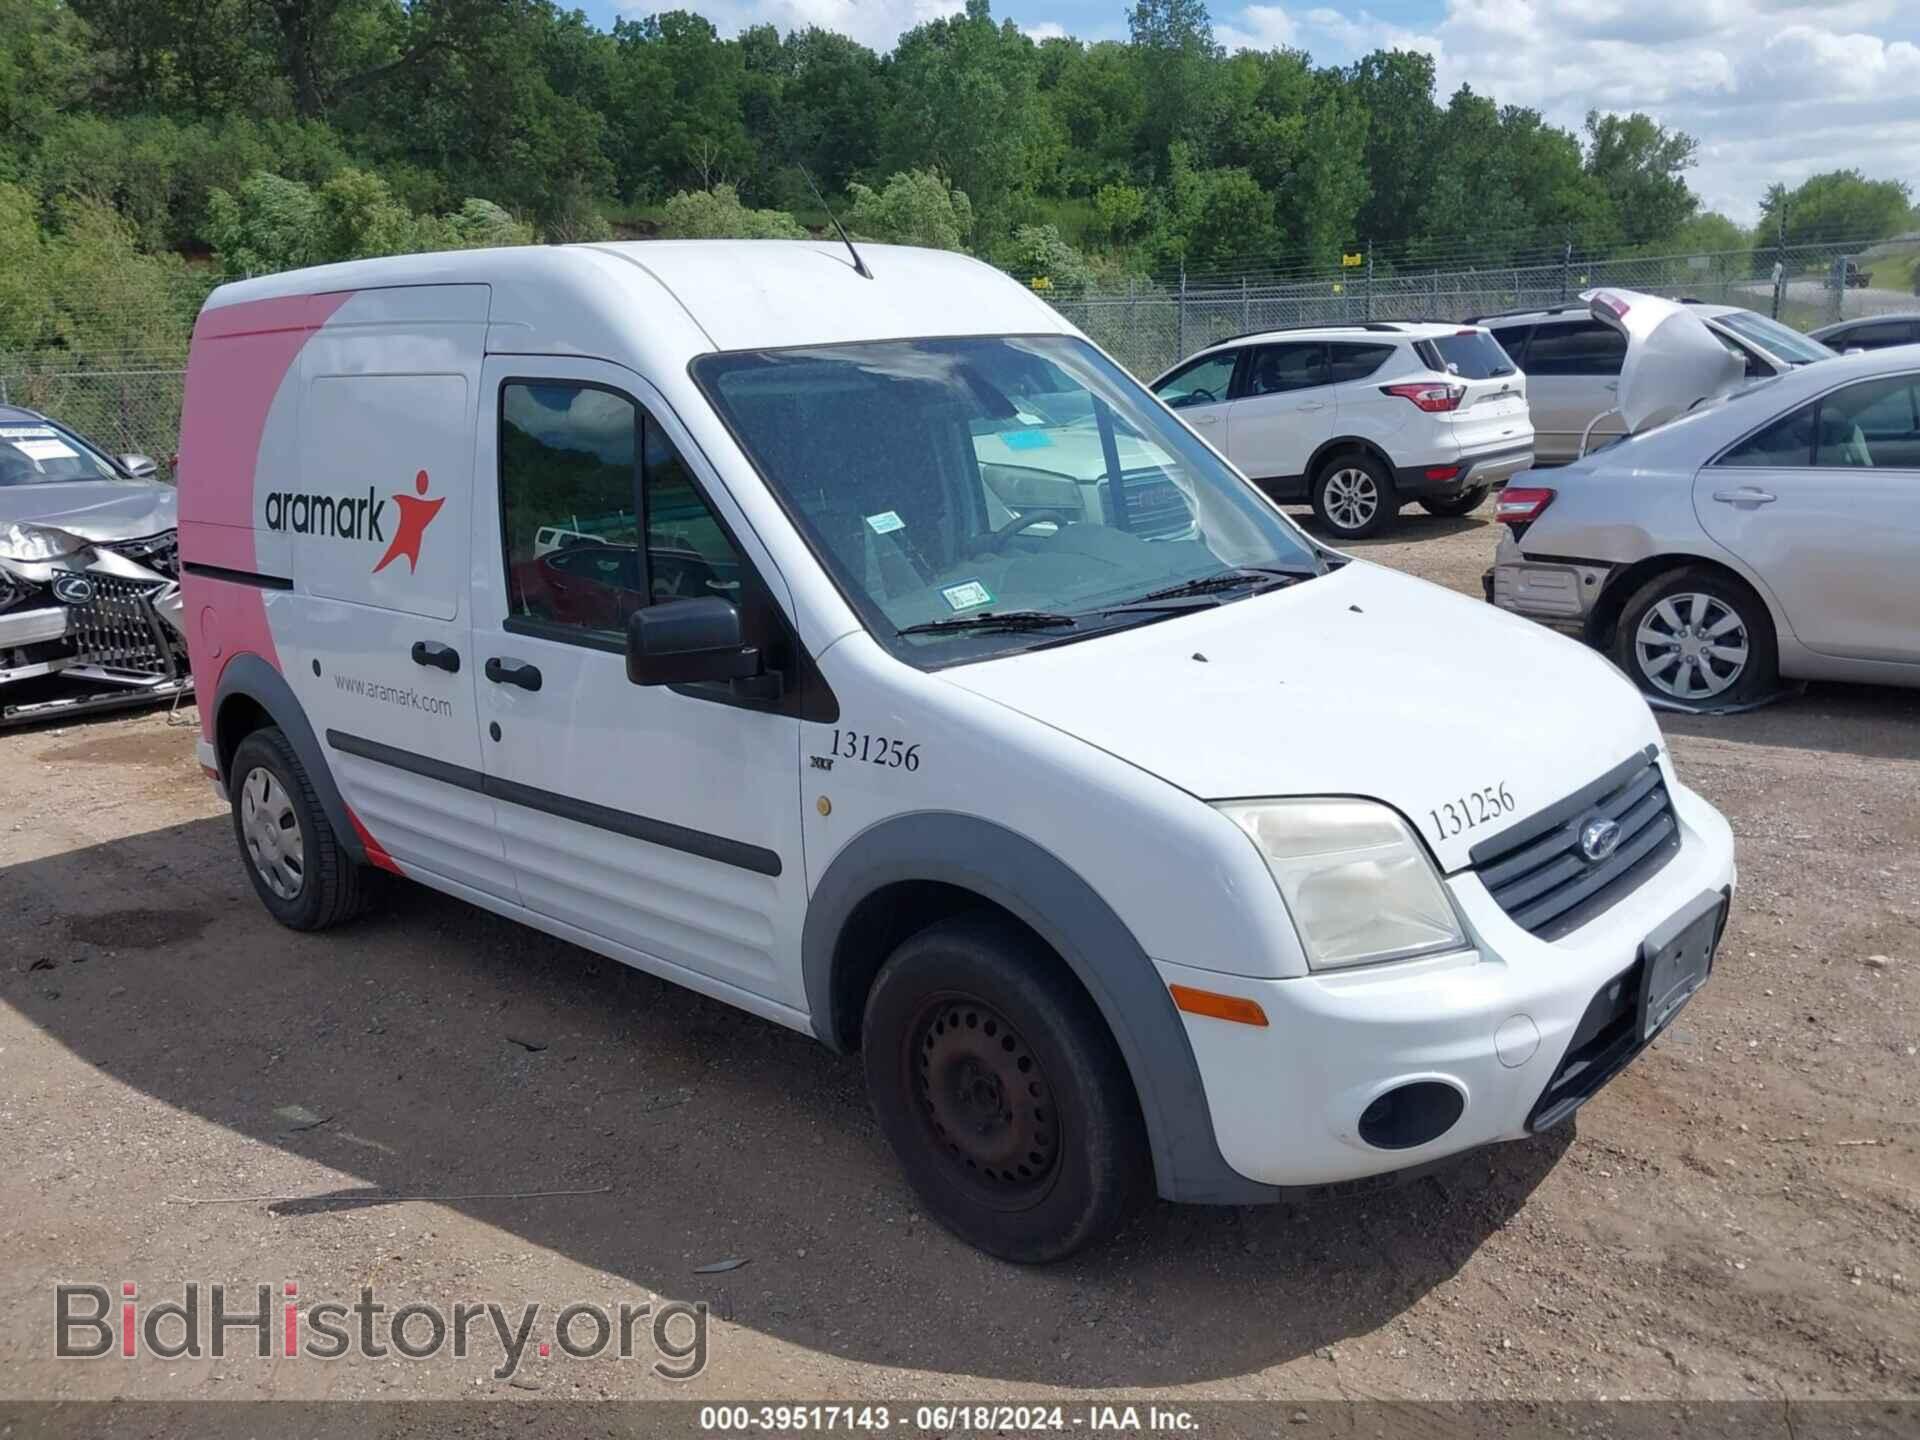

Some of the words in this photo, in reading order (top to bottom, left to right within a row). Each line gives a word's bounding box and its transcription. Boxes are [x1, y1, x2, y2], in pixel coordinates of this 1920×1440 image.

[265, 486, 385, 542] aramark
[333, 673, 453, 717] www.aramark.com
[831, 729, 921, 772] 131256
[1429, 781, 1515, 841] 131256
